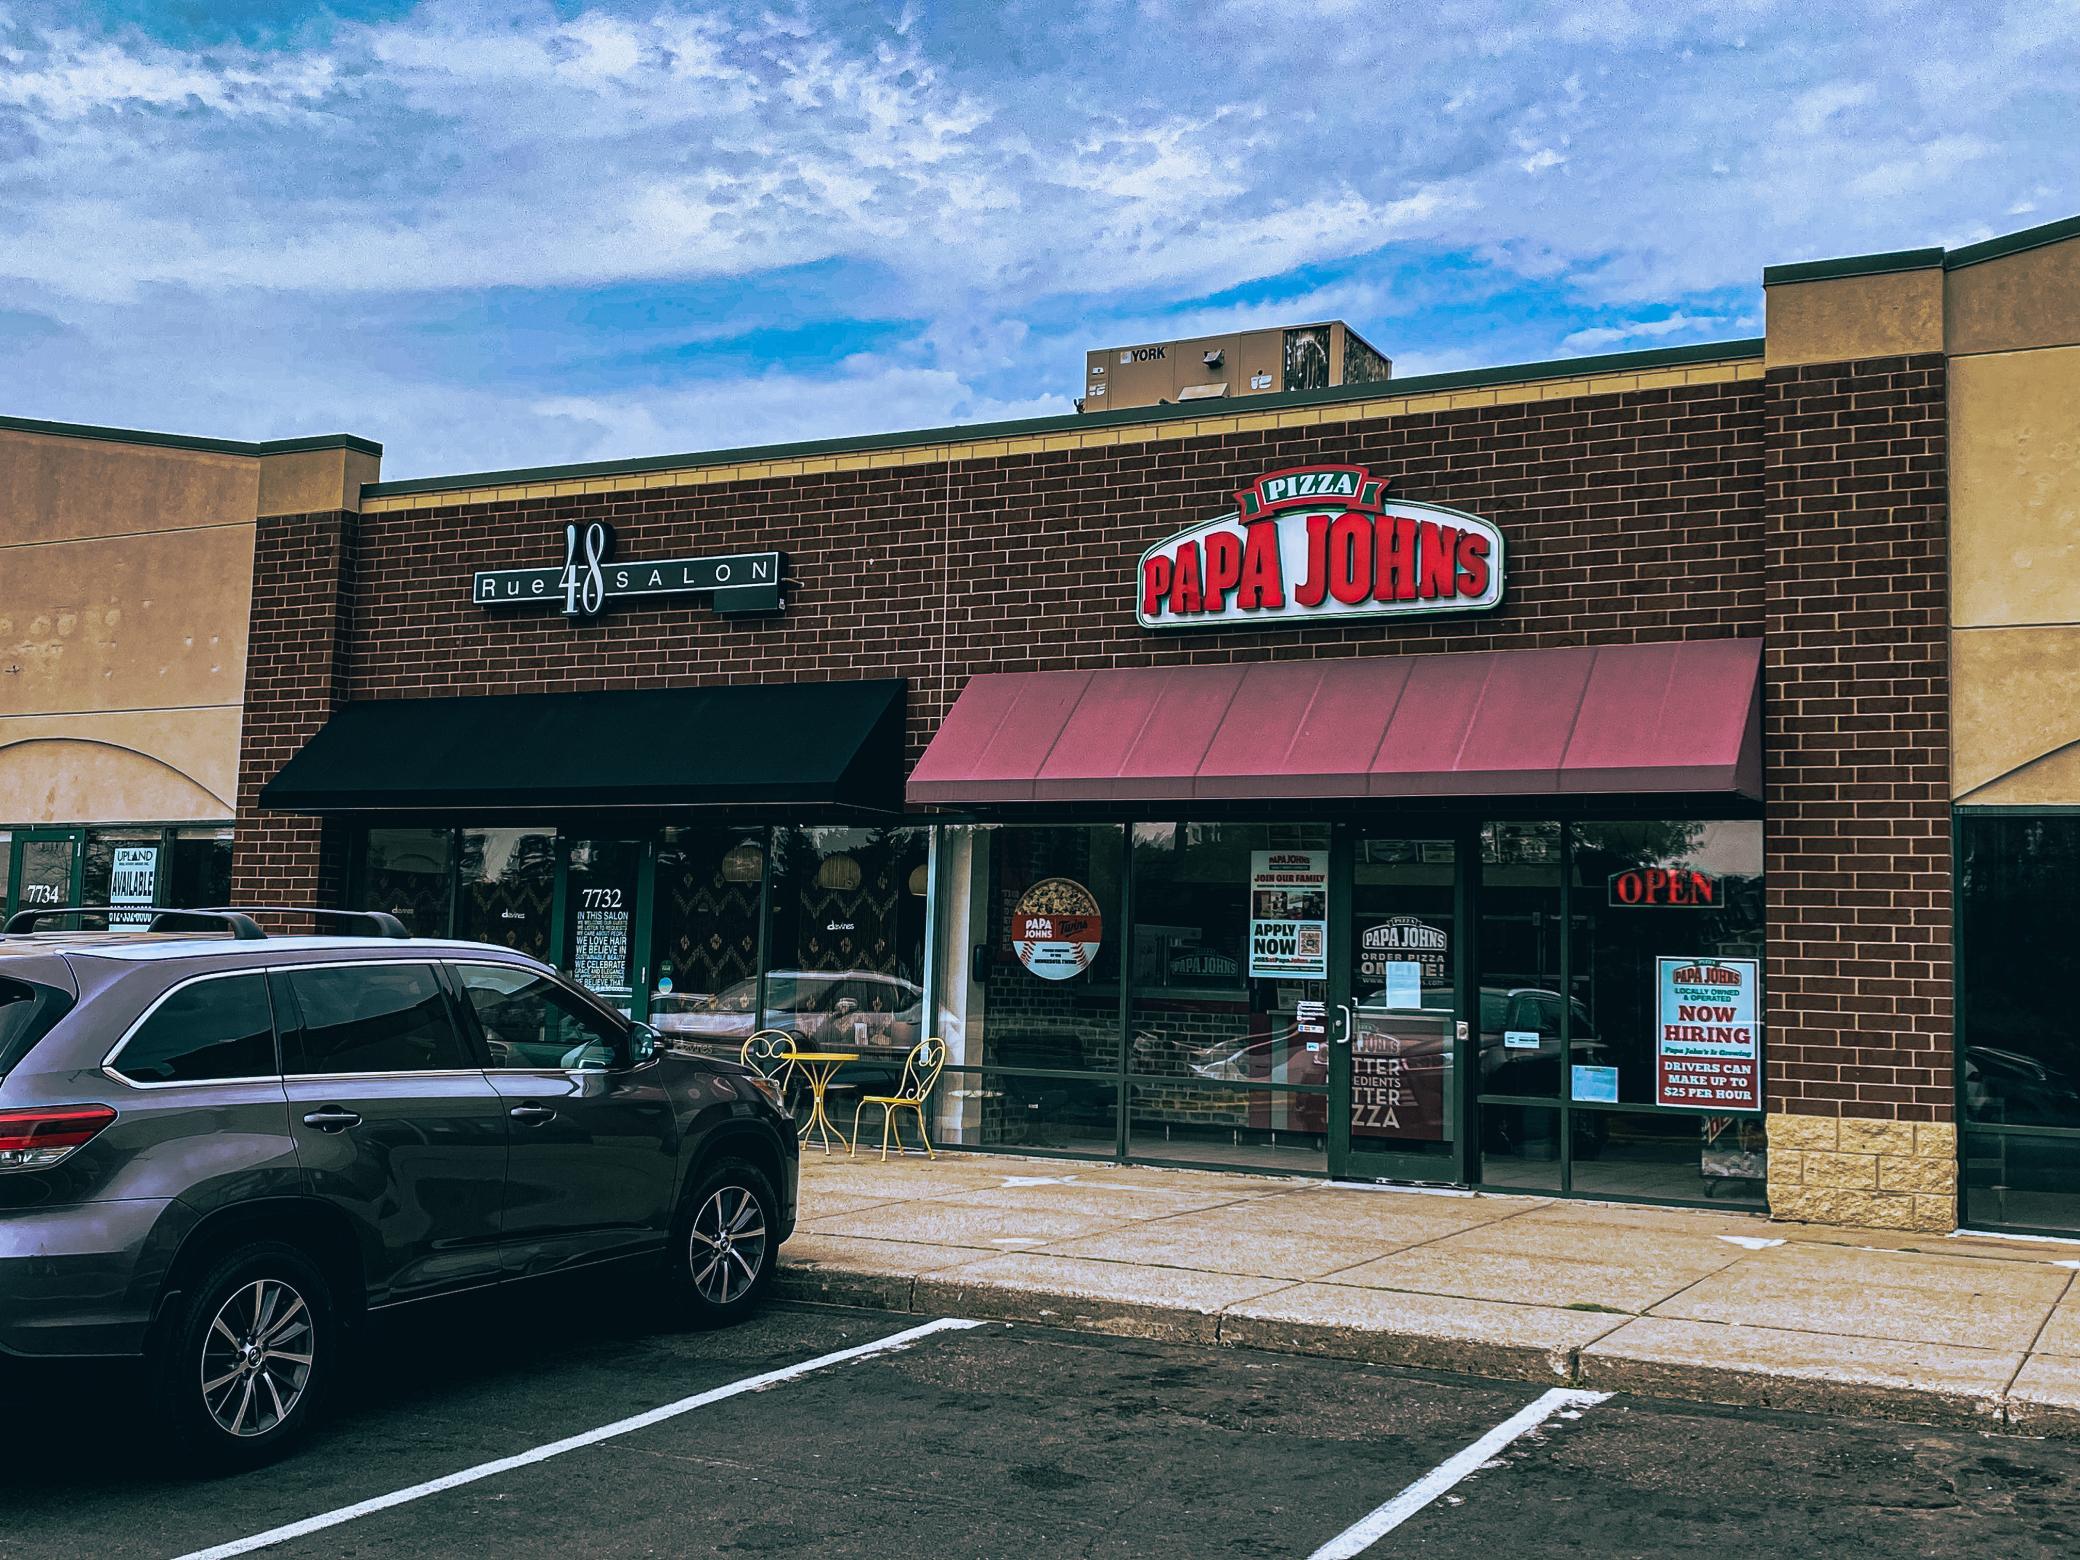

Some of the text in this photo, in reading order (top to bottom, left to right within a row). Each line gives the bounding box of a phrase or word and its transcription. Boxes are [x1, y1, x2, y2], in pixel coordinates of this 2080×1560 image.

[1131, 346, 1166, 362] YORK
[1268, 473, 1354, 501] PIZZA
[481, 522, 768, 617] Rue 48 SALON
[1144, 520, 1285, 616] PAPA
[117, 850, 153, 862] UPLAND
[111, 871, 153, 896] AVAILABLE
[1254, 874, 1275, 882] JOIN
[1296, 875, 1326, 883] FAMILY
[1617, 867, 1712, 904] OPEN
[27, 884, 59, 904] 7734
[582, 888, 622, 908] 7732
[577, 911, 629, 920] IN THIS SALON
[1025, 918, 1053, 929] PAPA
[1024, 930, 1053, 939] JOHNS
[1254, 924, 1297, 936] APPLY
[1365, 928, 1400, 948] PAPA
[576, 936, 627, 945] WE LOVE HAIR
[1253, 938, 1297, 956] NOW
[575, 945, 627, 955] WE BELIEVE IN
[1361, 952, 1445, 962] ORDER PIZZA
[575, 960, 626, 969] WE CELEBRATE
[1361, 961, 1445, 977] ONE!
[584, 979, 608, 987] BELIEVE
[610, 979, 624, 987] THAT
[1675, 967, 1702, 983] PAPA
[1678, 1005, 1737, 1022] NOW
[1664, 1025, 1752, 1044] HIRING
[1664, 1047, 1684, 1055] Papa
[1719, 1050, 1752, 1058] Growing
[1351, 1057, 1400, 1075] TTER
[1664, 1061, 1752, 1075] DRIVERS CAN
[1353, 1075, 1401, 1088] EDIENTS
[1668, 1074, 1748, 1087] MAKE UP TO
[1351, 1087, 1400, 1106] TTER
[1664, 1086, 1753, 1100] $25 PER HOUR
[1351, 1104, 1400, 1129] ZZA
